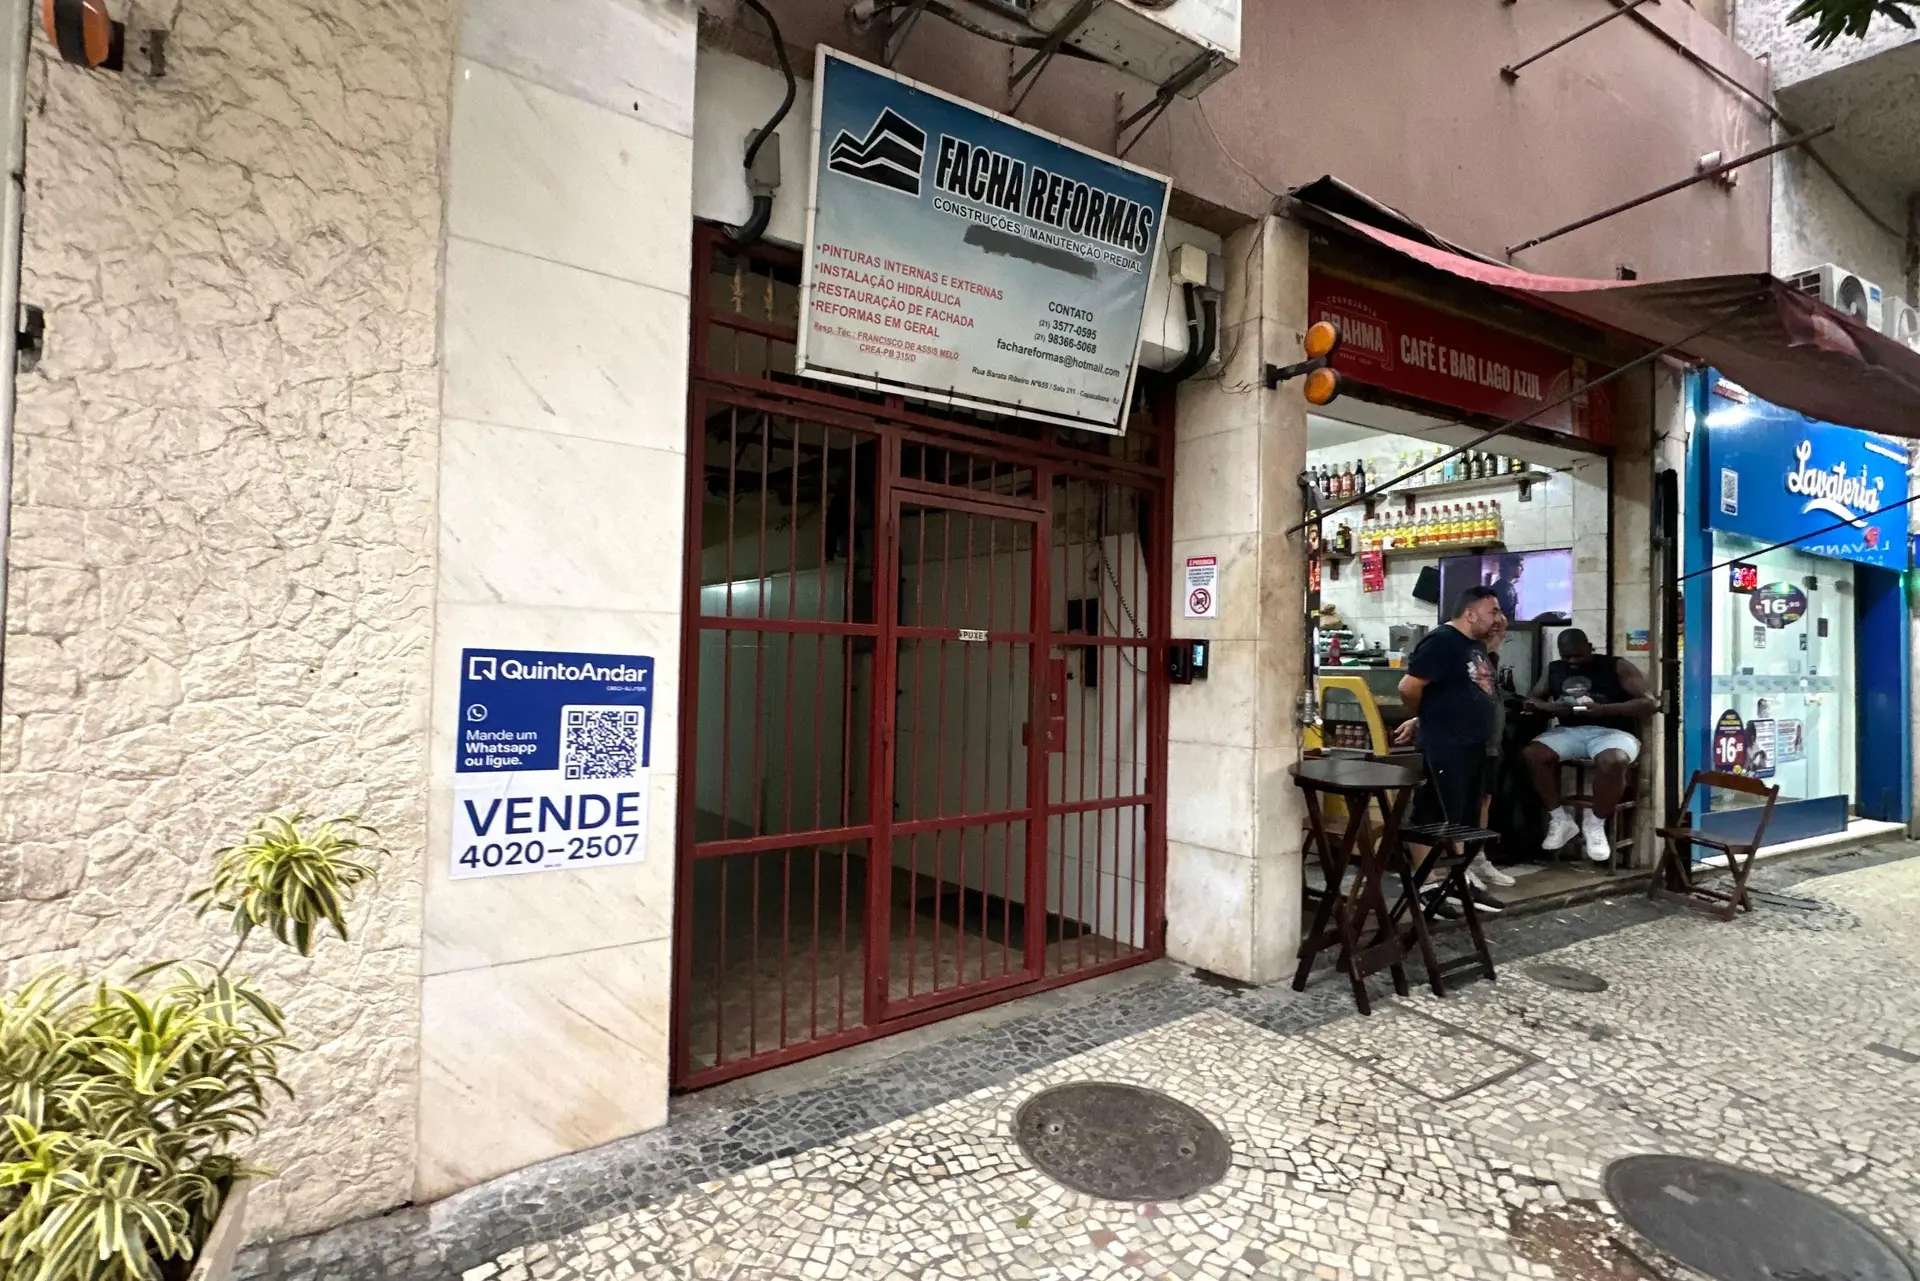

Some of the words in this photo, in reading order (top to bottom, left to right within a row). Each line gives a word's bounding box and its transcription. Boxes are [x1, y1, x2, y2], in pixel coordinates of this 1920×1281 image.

[934, 133, 1026, 216] FACHA
[1025, 165, 1154, 255] REFORMAS
[933, 197, 1021, 236] CONSTRUÇÕES
[1029, 228, 1101, 260] MANUTENÇÃO
[1102, 251, 1142, 273] PREDIAL
[820, 263, 894, 290] INSTALAÇÃO
[897, 282, 961, 308] HIDRÁULICA
[822, 244, 881, 269] PINTURAS
[884, 259, 938, 283] INTERNAS
[941, 275, 948, 286] E
[951, 277, 1004, 301] EXTERNAS
[815, 300, 881, 325] REFORMAS
[885, 316, 901, 329] EM
[904, 320, 940, 338] GERAL
[818, 282, 905, 311] RESTAURAÇÃO
[908, 303, 922, 316] DE
[925, 307, 974, 328] FACHADA
[1048, 301, 1093, 322] CONTATO
[1034, 333, 1046, 343] (21)
[1048, 332, 1097, 354] 98366-5068
[1039, 319, 1050, 330] (21)
[1052, 319, 1097, 340] 3577-0595
[857, 331, 903, 348] FRANCISCO
[904, 341, 915, 350] DE
[917, 343, 938, 356] ASSIS
[939, 349, 959, 361] MELO
[859, 343, 895, 359] CREA-PB
[996, 338, 1121, 378] fachareformas@hotmail.com
[972, 366, 985, 376] Rua
[1008, 374, 1029, 385] Ribeiro
[1053, 384, 1065, 393] Sala
[1400, 335, 1435, 373] CAFÉ
[1439, 349, 1448, 375] E
[1449, 349, 1477, 383] BAR
[1479, 360, 1511, 393] LAGO
[1513, 369, 1542, 401] AZUL
[1787, 440, 1881, 513] Lavateria
[963, 631, 984, 640] PUXE
[500, 659, 648, 683] QuintoAndar
[465, 743, 537, 755] Whatsapp
[466, 729, 513, 741] Mande
[516, 731, 537, 741] um
[465, 756, 483, 766] ou
[486, 755, 523, 769] ligue.
[464, 792, 641, 837] VENDE
[459, 833, 640, 868] 4020-2507
